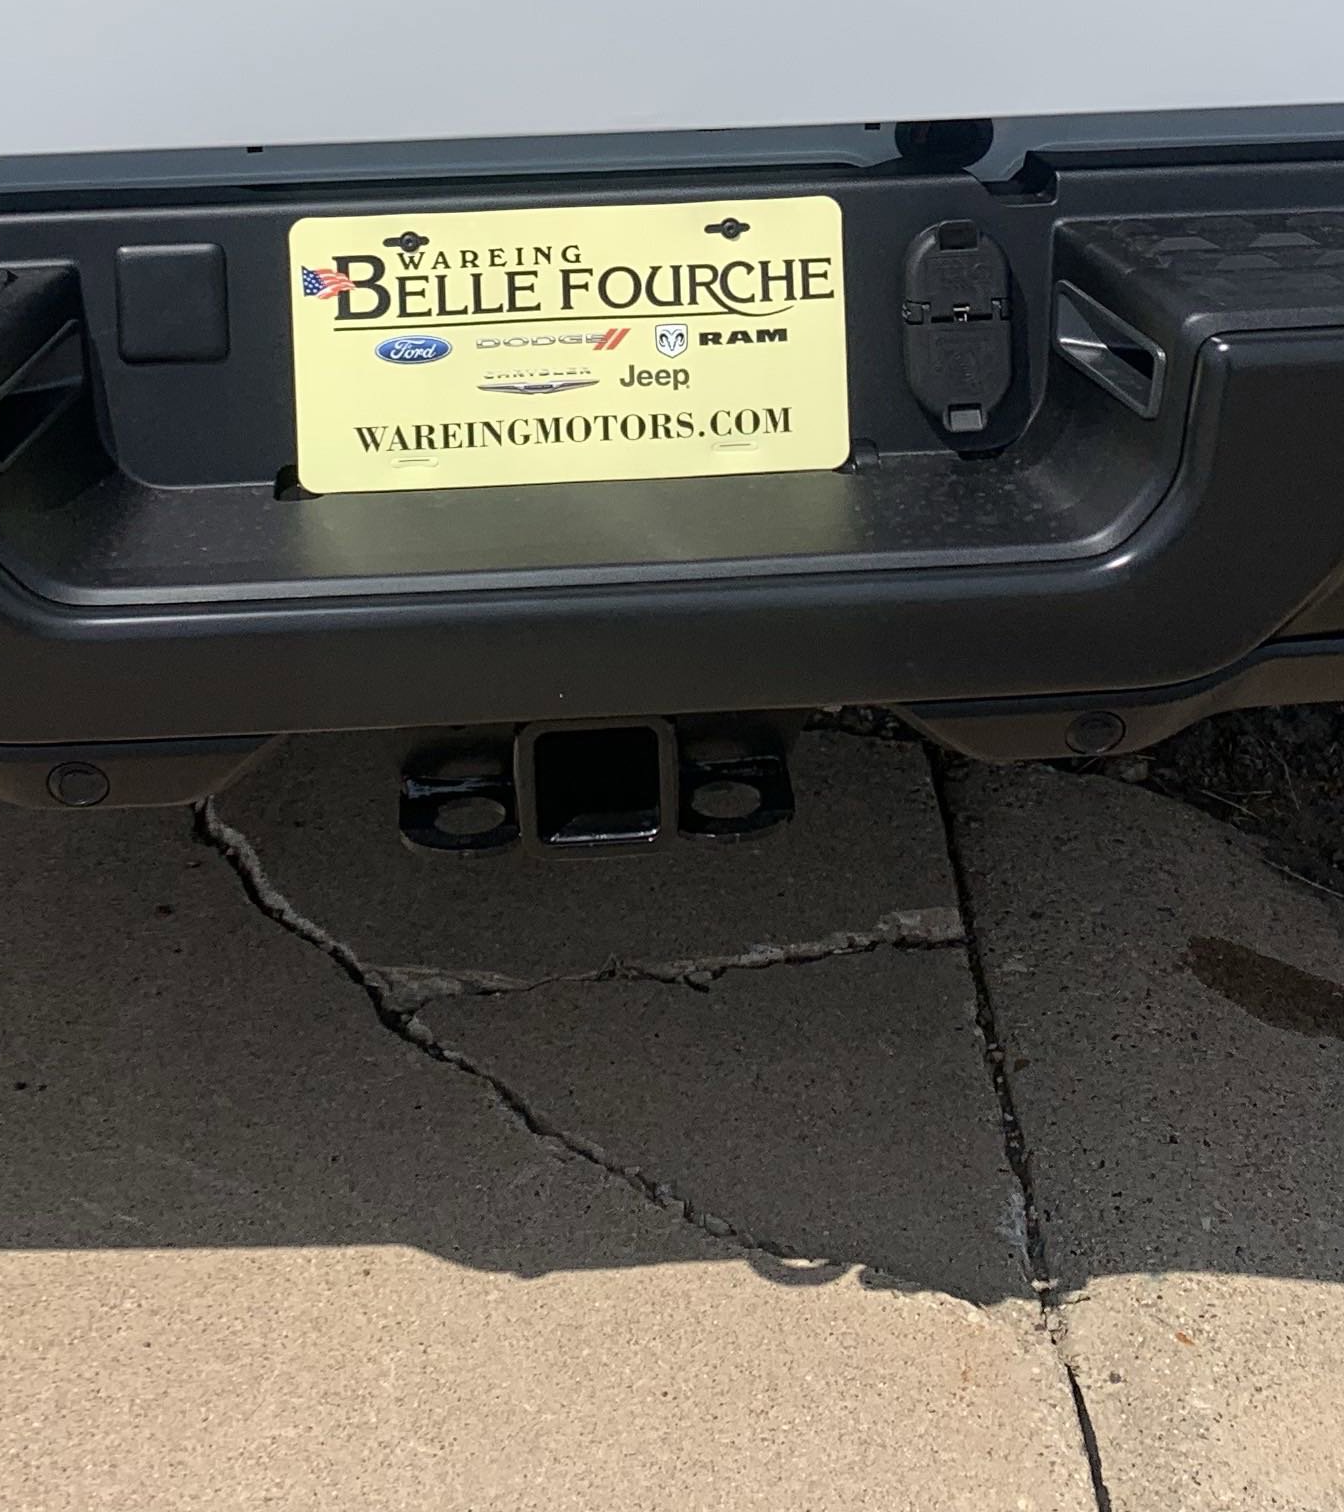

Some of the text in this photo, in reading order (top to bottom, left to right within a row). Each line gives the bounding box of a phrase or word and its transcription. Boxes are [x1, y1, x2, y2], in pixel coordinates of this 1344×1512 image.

[397, 244, 582, 271] WAREING
[333, 255, 836, 320] BELLE FOURCHE
[388, 338, 436, 360] Ford
[476, 334, 607, 349] DODGE
[699, 327, 788, 346] RAM
[619, 364, 690, 390] Jeep
[354, 406, 793, 454] WAREINGMOTORS.COM
